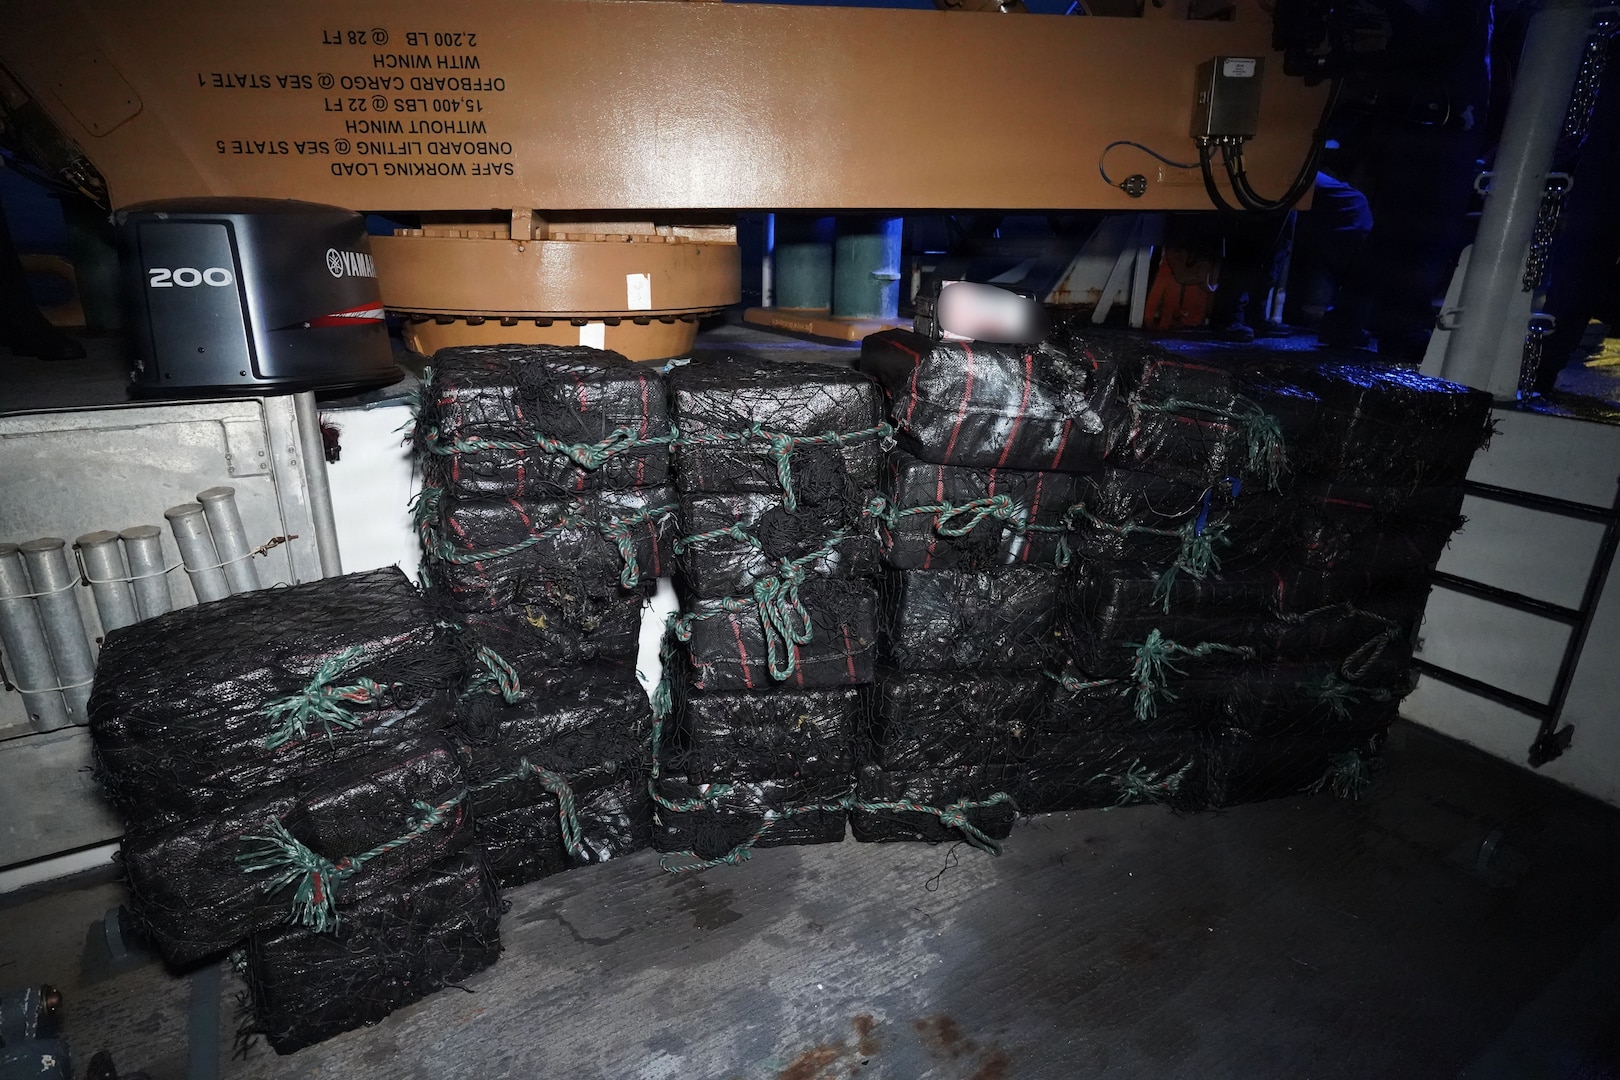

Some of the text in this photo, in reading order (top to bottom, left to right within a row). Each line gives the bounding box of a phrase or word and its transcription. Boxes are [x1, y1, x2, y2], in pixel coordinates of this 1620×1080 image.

[323, 28, 477, 48] 2,200 LB @ 28 FT
[373, 54, 481, 69] WITH WINCH
[198, 72, 506, 91] OFFBOARD CARGO @ SEA STATE 1
[324, 95, 484, 113] 15,400 LBS @ 22 FT
[345, 119, 487, 135] WITHOUT WINCH
[216, 138, 513, 156] ONBOARD LIFTING @ SEA STATE 5
[331, 162, 514, 177] SAFE WORKING LOAD
[149, 267, 233, 288] 200
